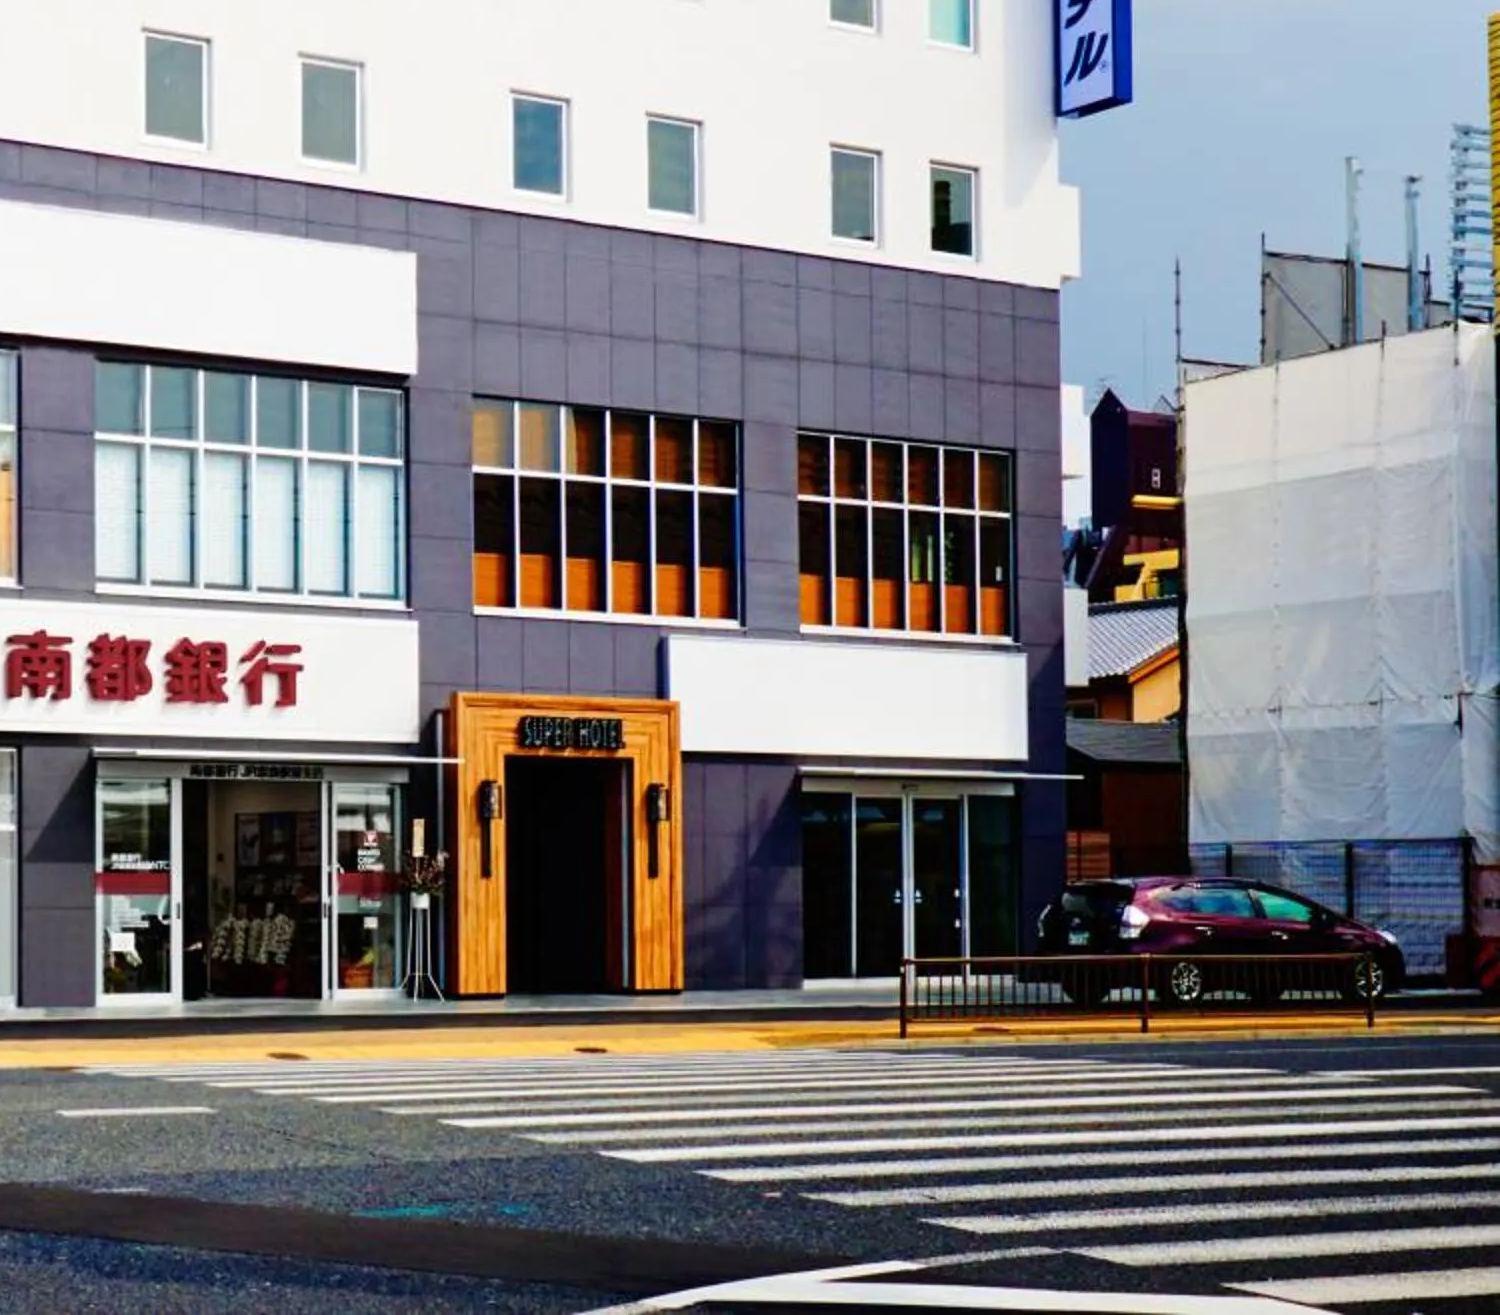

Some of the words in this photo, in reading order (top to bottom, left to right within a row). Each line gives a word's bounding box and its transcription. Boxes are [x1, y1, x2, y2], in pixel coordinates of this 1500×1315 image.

[5, 629, 303, 707] 南都銀行
[519, 715, 573, 750] SUPER
[573, 718, 627, 751] HOTEL
